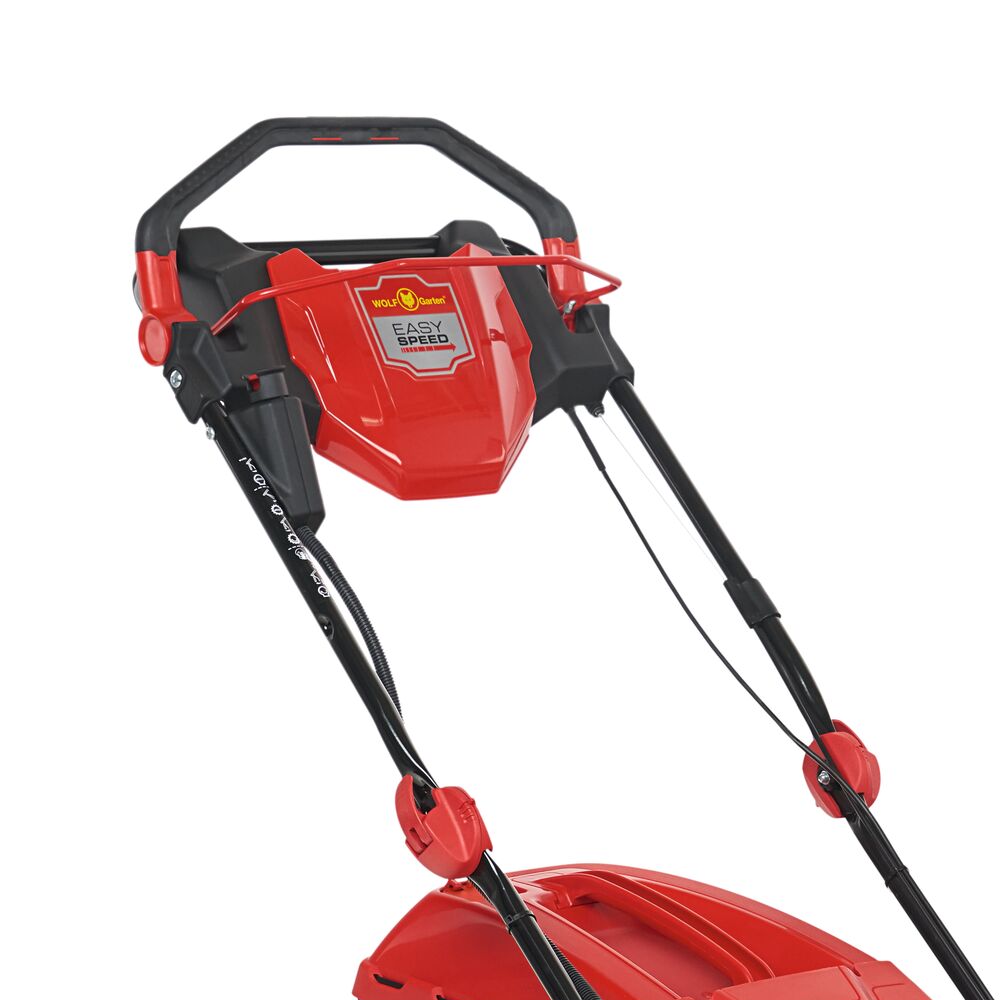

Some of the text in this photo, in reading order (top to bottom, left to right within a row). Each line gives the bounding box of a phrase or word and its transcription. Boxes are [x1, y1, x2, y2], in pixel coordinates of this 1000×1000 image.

[372, 297, 445, 308] WOLF Garten
[392, 321, 441, 335] EASY
[397, 334, 448, 346] SPEED
